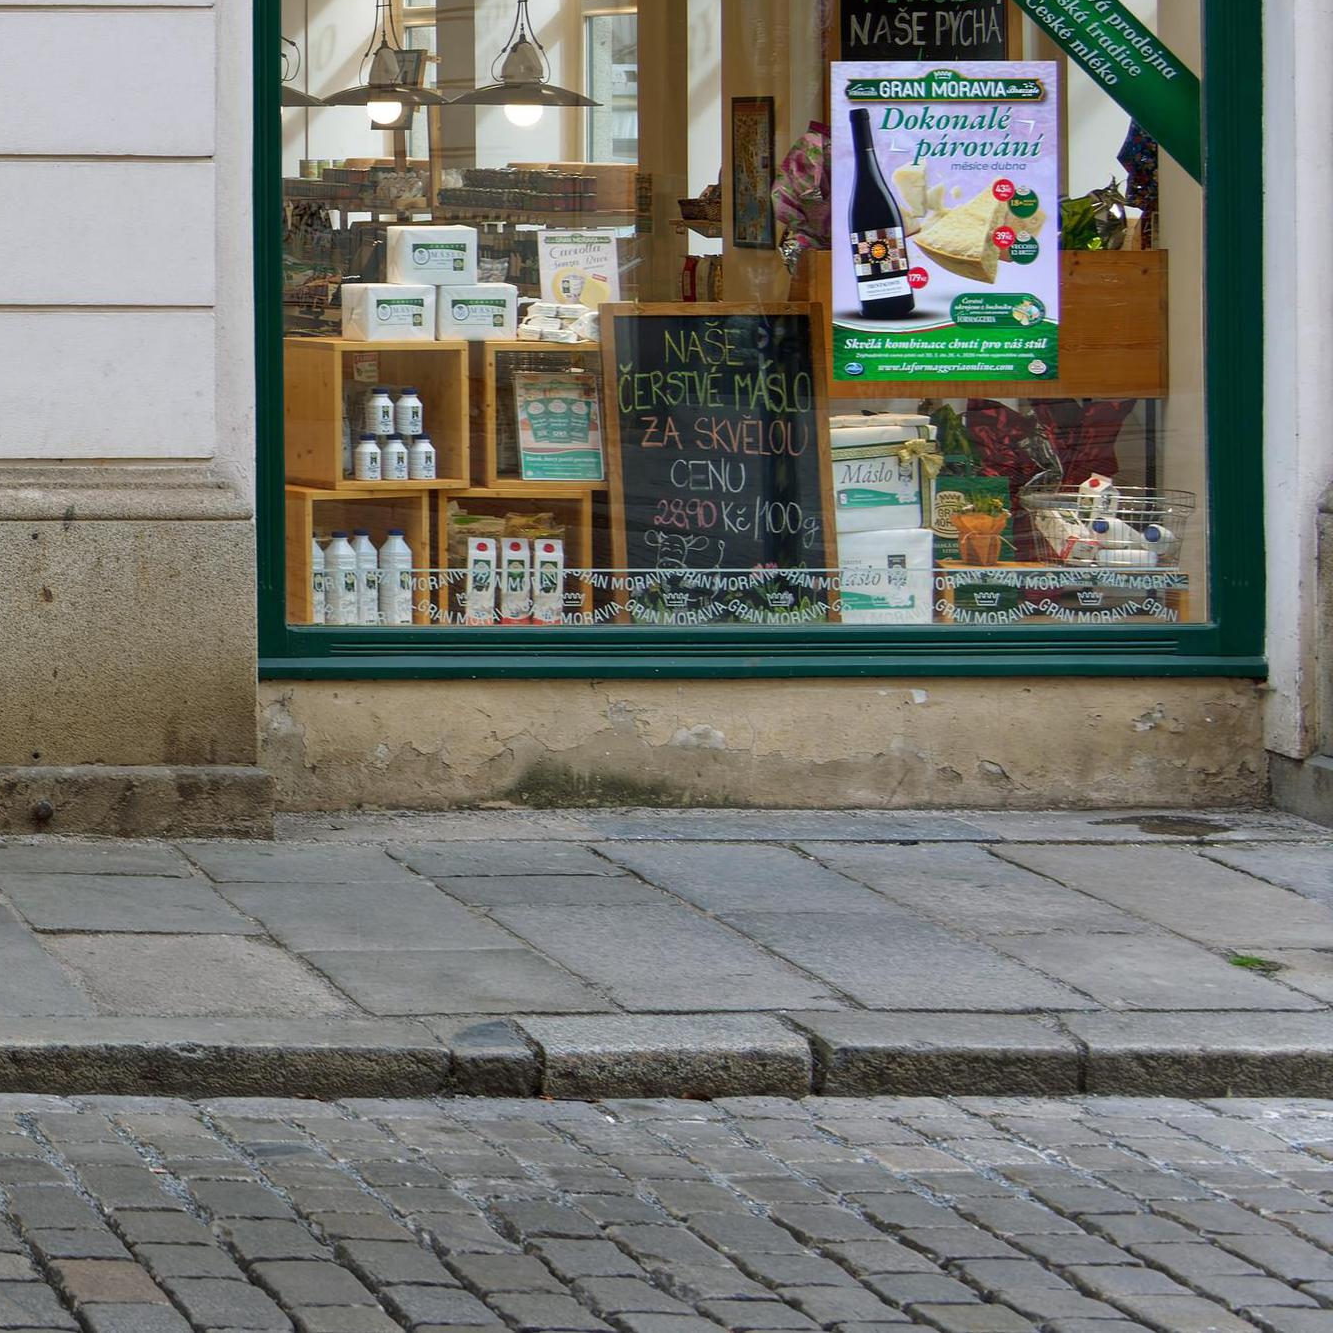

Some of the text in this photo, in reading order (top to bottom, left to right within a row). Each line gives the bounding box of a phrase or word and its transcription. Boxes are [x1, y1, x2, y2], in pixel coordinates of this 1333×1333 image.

[849, 5, 1003, 47] NAŠE PÝCHA
[1069, 37, 1118, 86] mléko
[1087, 20, 1142, 78] tradice
[1107, 12, 1178, 83] prodejna
[879, 80, 926, 98] GRAN
[932, 81, 1007, 98] MORAVIA
[879, 105, 1011, 131] Dokonalé
[912, 133, 1044, 165] párování
[951, 161, 1027, 171] měsíce dubna
[665, 322, 744, 366] NAŠE
[845, 337, 881, 349] Skvělá
[885, 337, 946, 350] kombinace
[981, 340, 1001, 352] pro
[1003, 338, 1022, 349] váš
[618, 362, 724, 413] ČERSTVÉ
[641, 417, 683, 450] ZA
[694, 414, 809, 456] SKVĚLOU
[670, 458, 746, 493] CENU
[840, 463, 893, 485] Máslo
[419, 601, 452, 625] GRAN
[562, 600, 623, 625] MORAVIA
[624, 600, 659, 624] GRAN
[663, 600, 727, 625] MORAVIA
[728, 600, 764, 624] GRAN
[767, 600, 831, 625] MORAVIA
[935, 599, 970, 623] GRAN
[974, 599, 1037, 624] MORAVIA
[1038, 599, 1074, 623] GRAN
[1077, 599, 1141, 624] MORAVIA
[1141, 598, 1177, 622] GRAN
